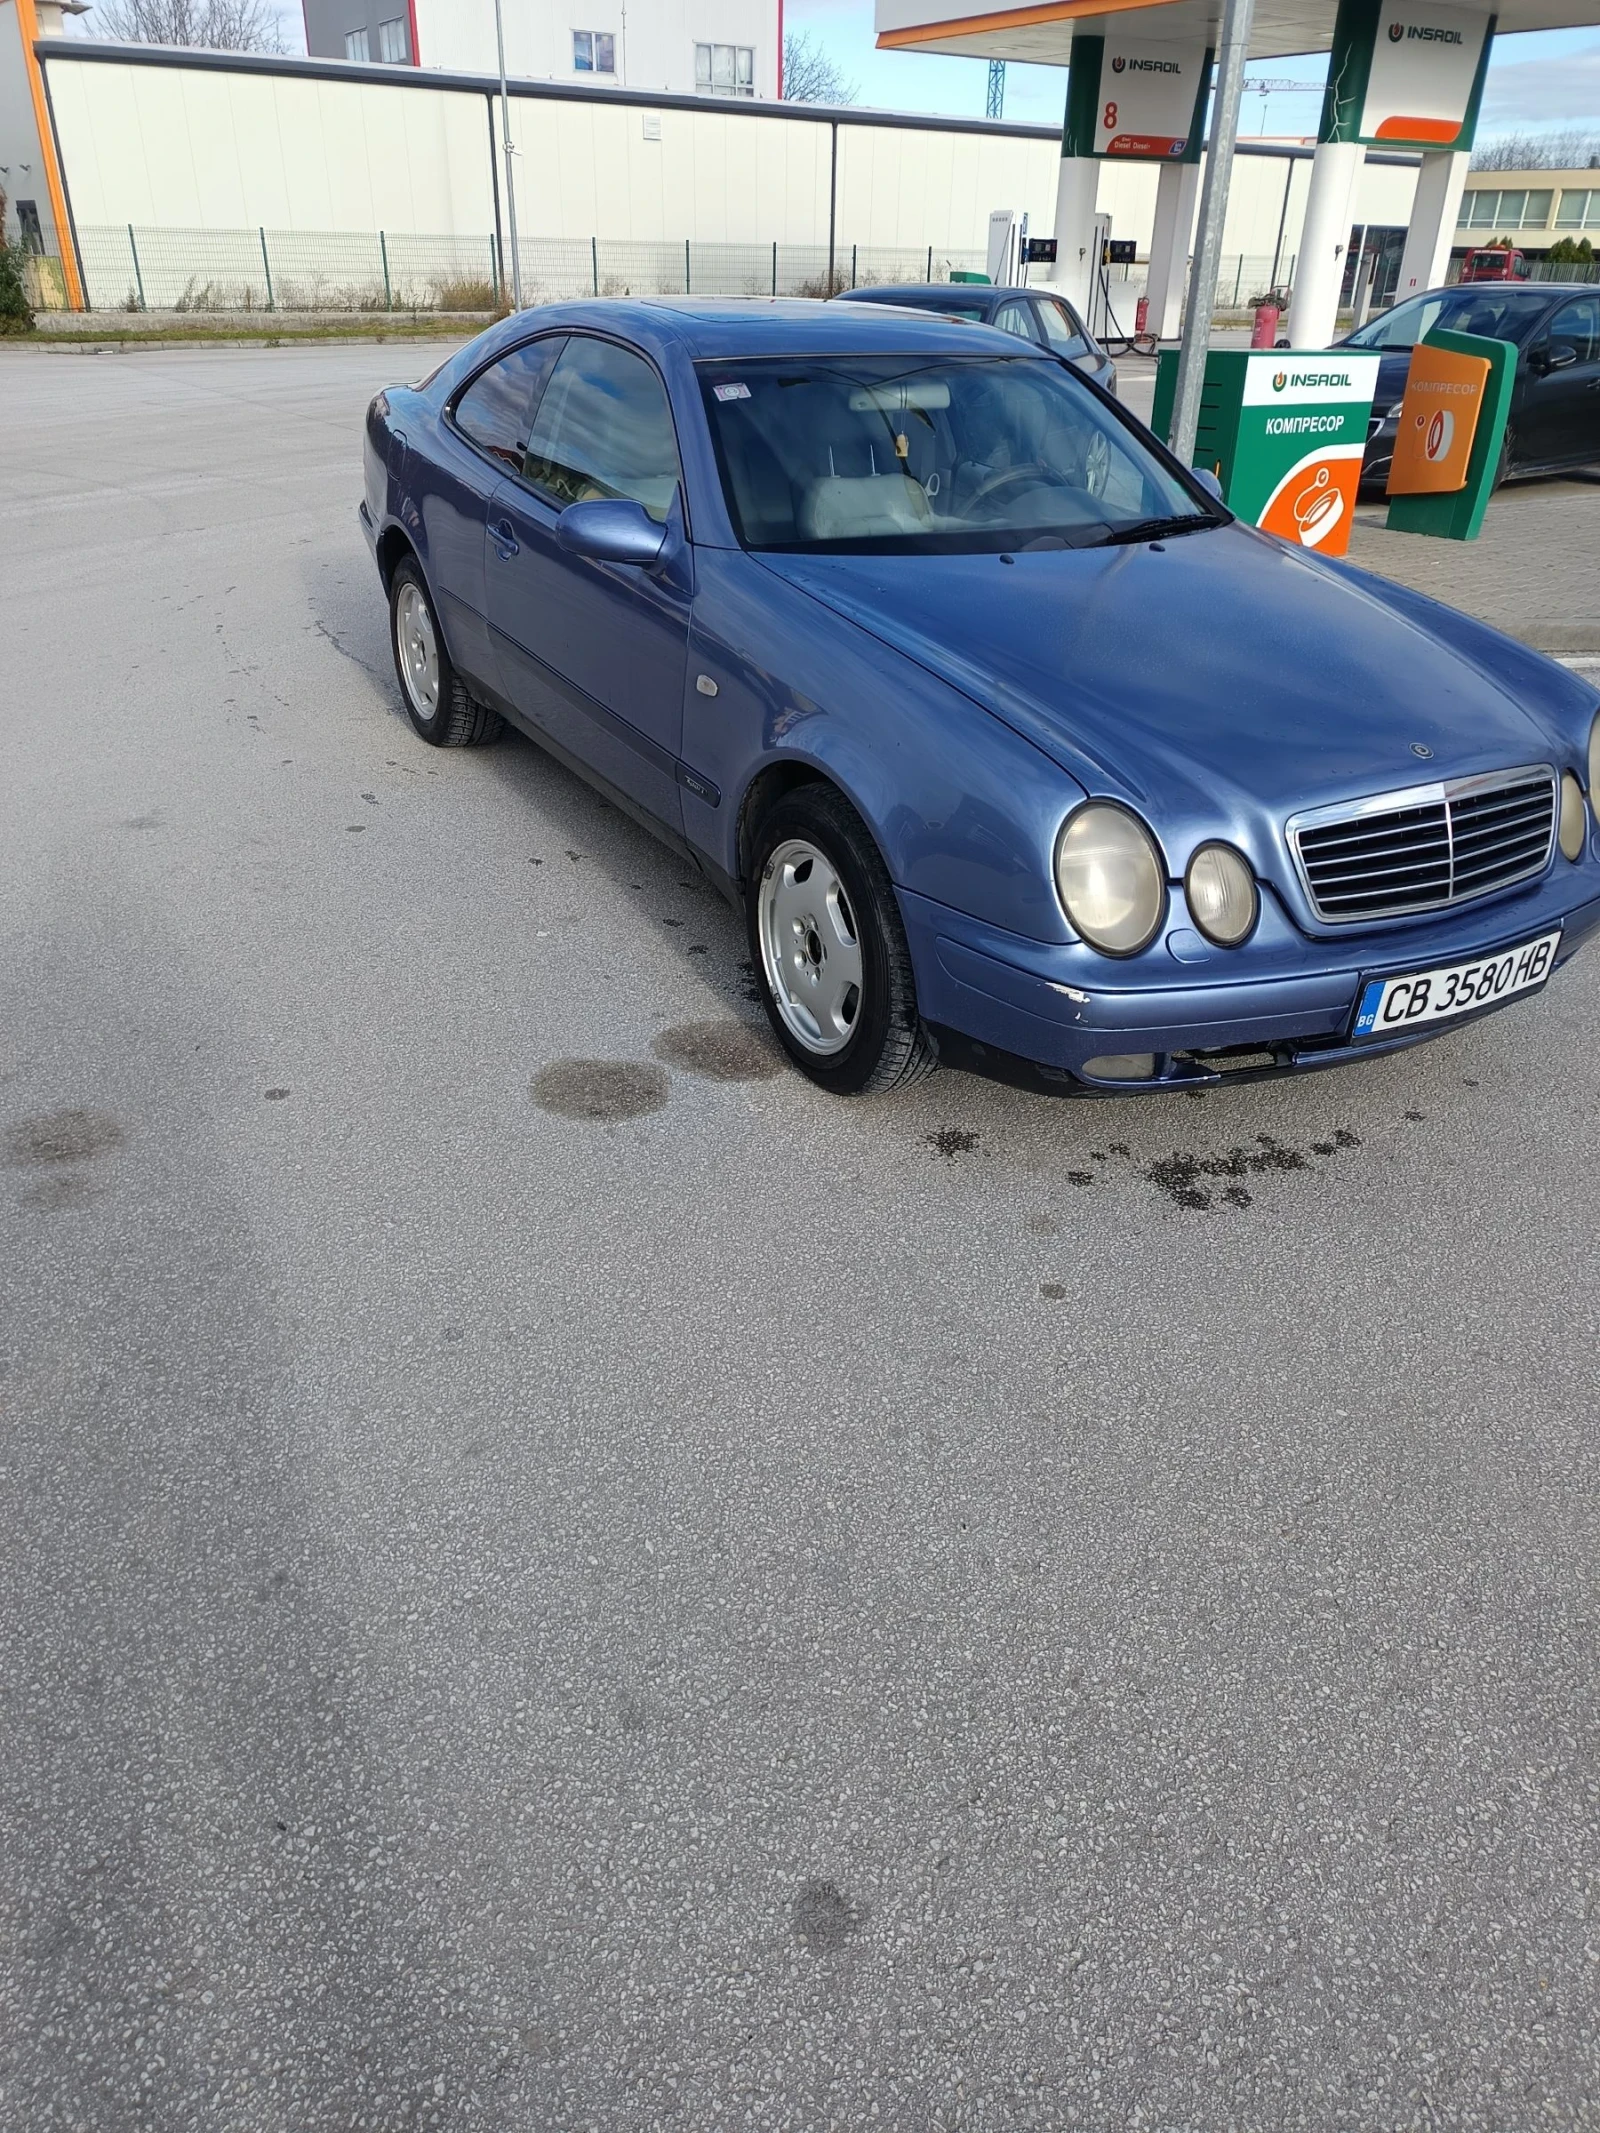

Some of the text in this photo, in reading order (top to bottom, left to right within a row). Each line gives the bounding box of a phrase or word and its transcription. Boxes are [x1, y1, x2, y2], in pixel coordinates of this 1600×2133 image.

[1408, 26, 1463, 44] INSAOIL
[1129, 59, 1181, 73] INSAOIL
[1103, 102, 1118, 129] 8
[1114, 141, 1131, 149] Diesel
[1290, 373, 1352, 386] INSAOIL
[1411, 381, 1478, 395] КОМПРЕСОР
[1265, 415, 1345, 435] КОМПРЕСОР
[1383, 940, 1552, 1023] CB 3580 HB
[1357, 1013, 1374, 1028] BG
